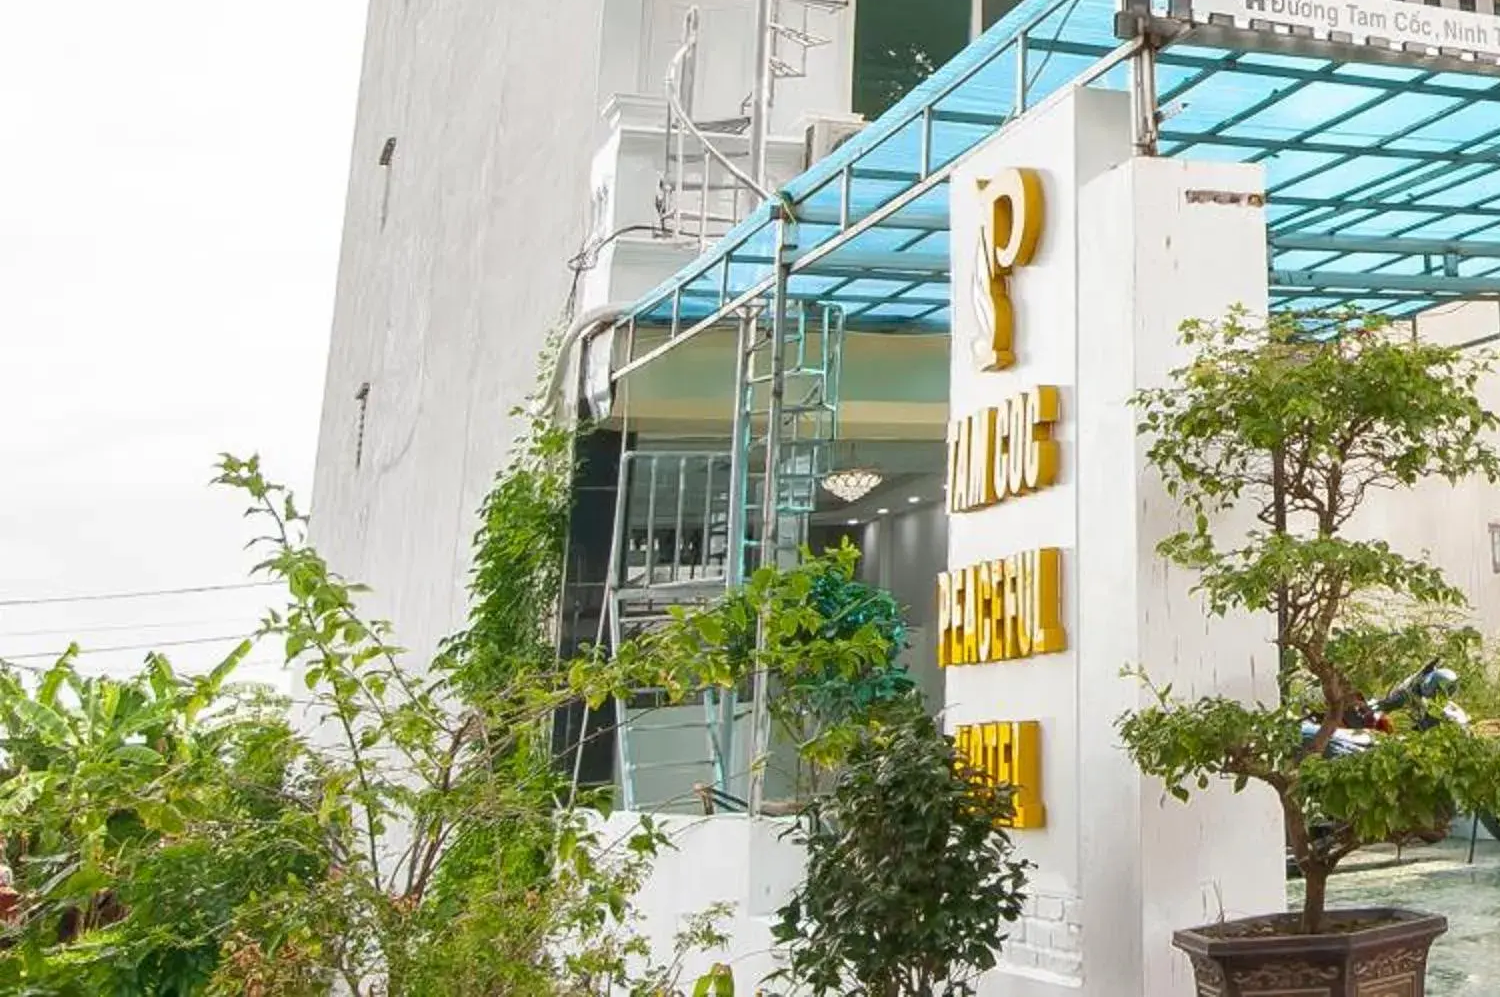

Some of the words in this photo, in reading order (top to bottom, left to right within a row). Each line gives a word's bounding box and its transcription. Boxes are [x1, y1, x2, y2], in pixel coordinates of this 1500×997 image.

[1346, 4, 1387, 31] Tam
[1443, 19, 1488, 46] Ninh
[936, 546, 1068, 668] PEACEFUL
